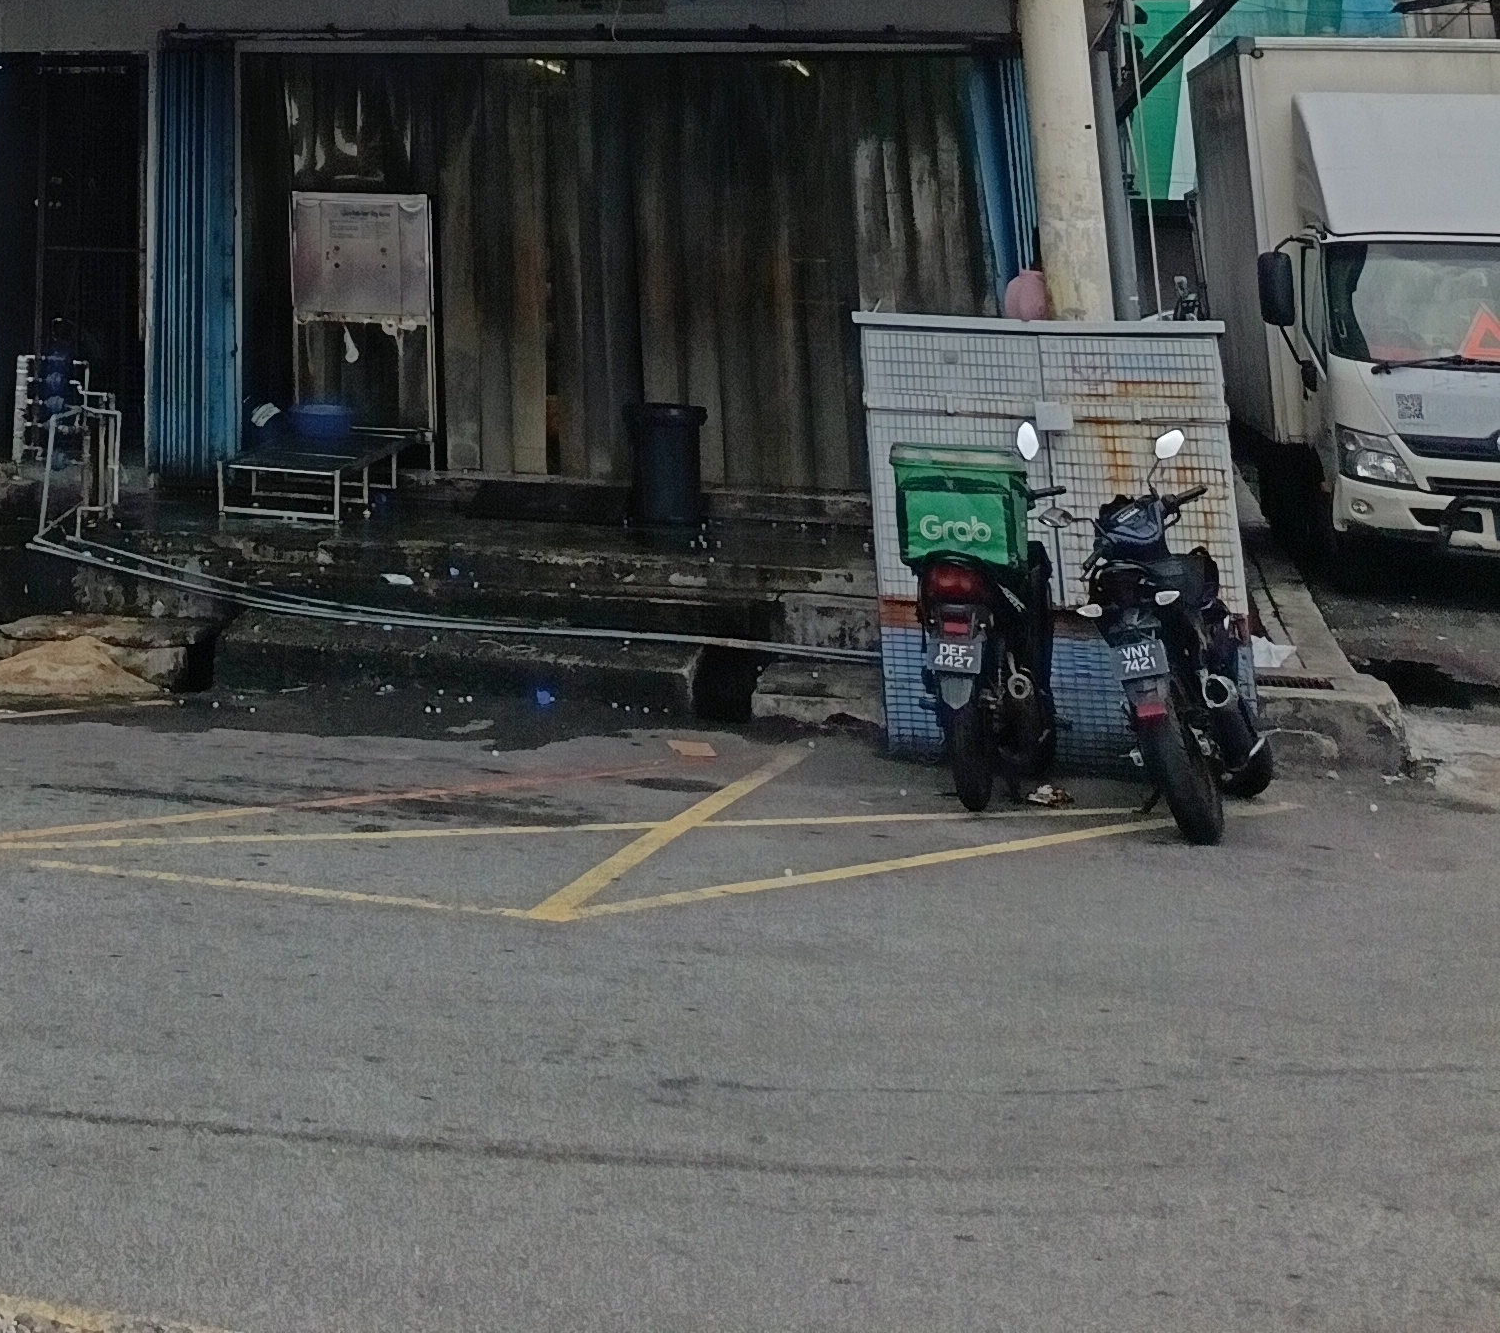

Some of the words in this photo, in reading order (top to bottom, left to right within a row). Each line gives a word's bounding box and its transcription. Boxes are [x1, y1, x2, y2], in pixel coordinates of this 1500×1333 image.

[919, 514, 992, 543] Grab
[939, 643, 968, 656] DEF
[1121, 644, 1150, 660] VNY
[934, 654, 974, 668] 4427
[1121, 656, 1157, 673] 7421
